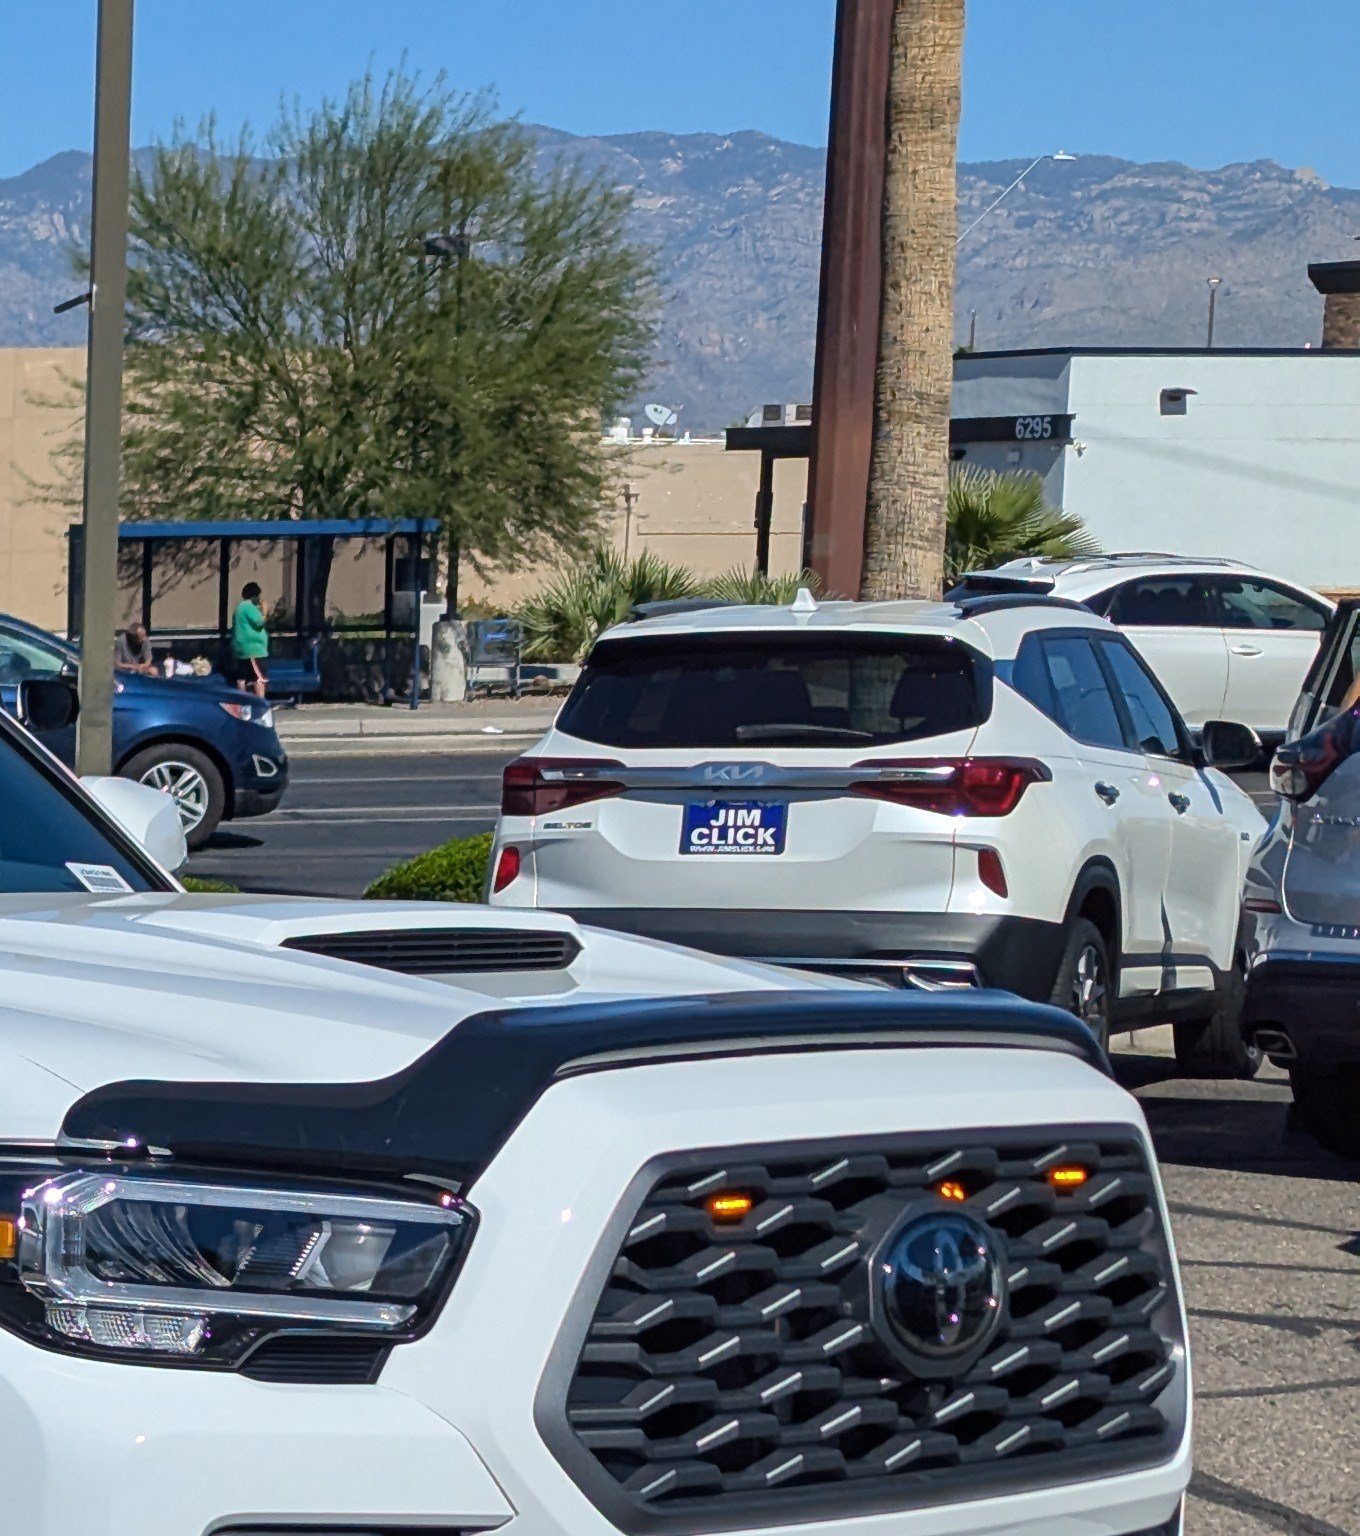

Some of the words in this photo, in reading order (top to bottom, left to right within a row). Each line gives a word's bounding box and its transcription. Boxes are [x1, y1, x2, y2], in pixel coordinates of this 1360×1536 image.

[1015, 416, 1052, 439] 6295
[709, 808, 762, 827] JIM
[690, 827, 778, 845] CLICK
